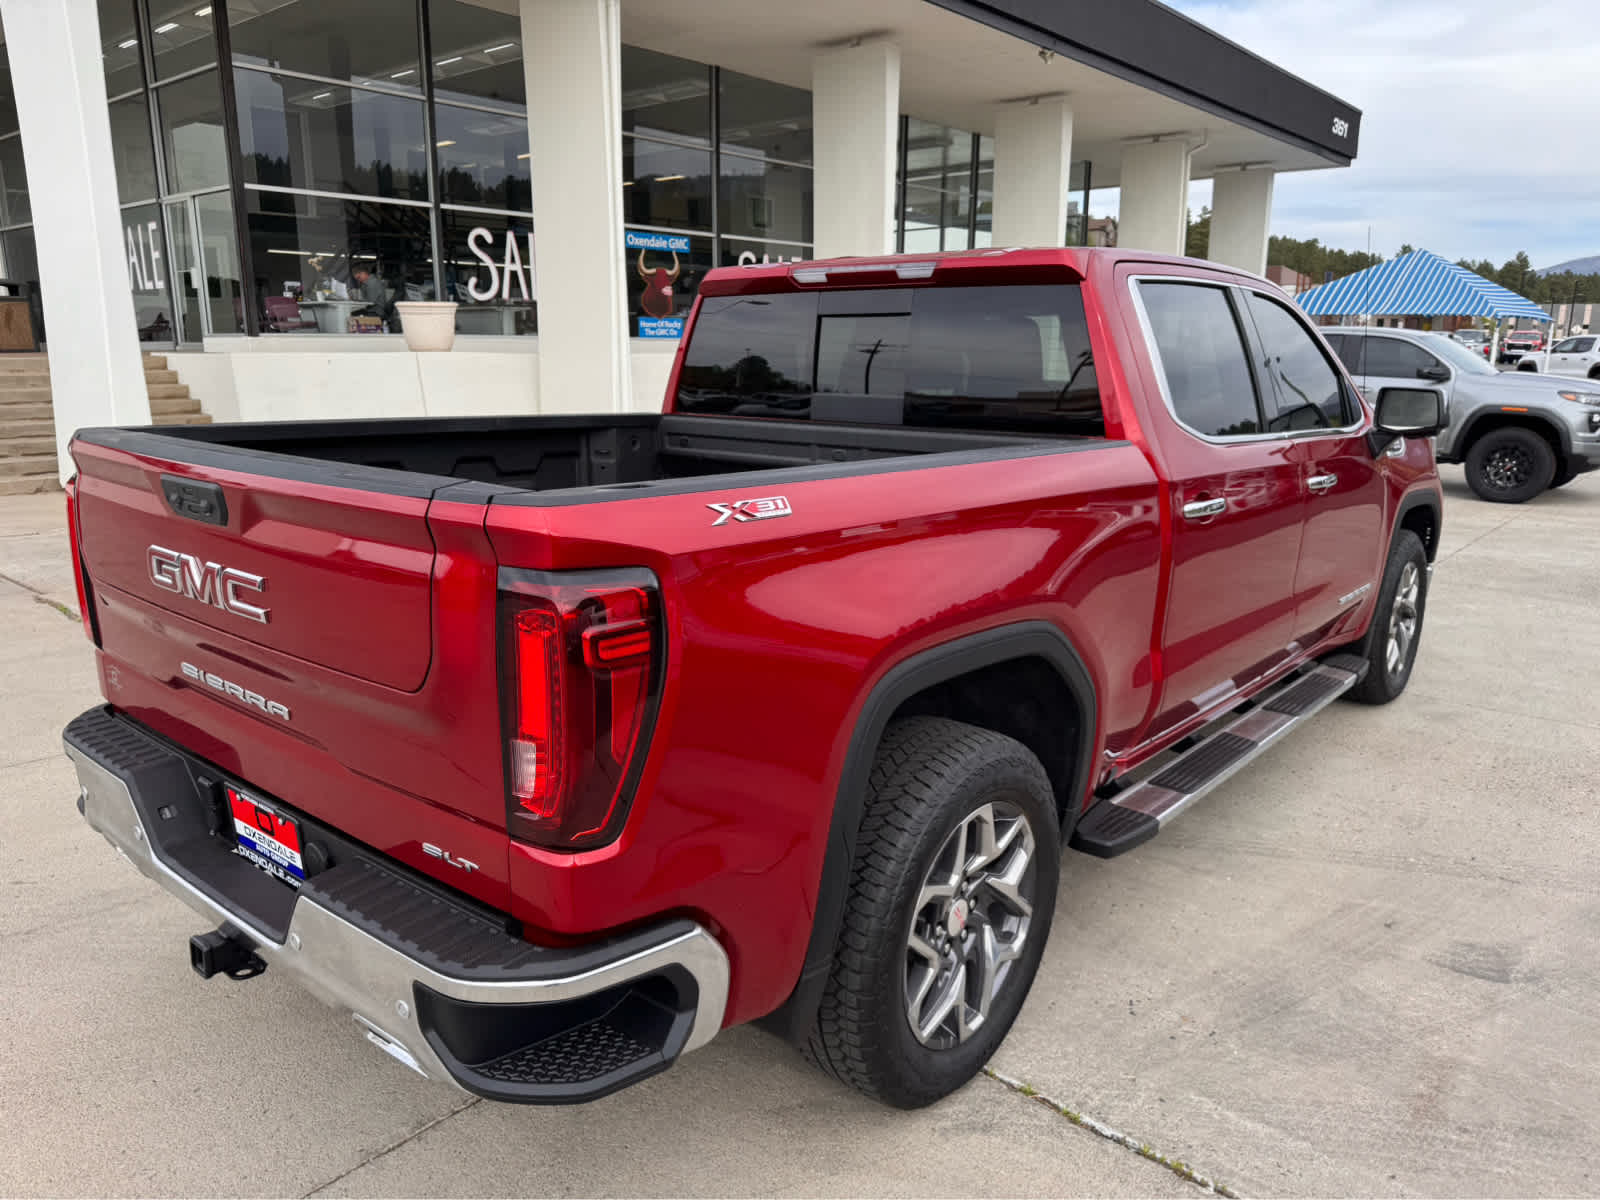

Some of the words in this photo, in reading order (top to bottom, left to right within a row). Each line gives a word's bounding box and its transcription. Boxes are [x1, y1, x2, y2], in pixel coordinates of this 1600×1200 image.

[1332, 117, 1349, 139] 361
[127, 221, 165, 291] ALE
[627, 234, 668, 249] Oxendale
[668, 238, 690, 250] GMC
[705, 496, 792, 526] X31
[147, 544, 269, 624] GMC
[181, 661, 291, 720] SIERRA
[243, 825, 297, 863] OXENDALE
[422, 841, 480, 872] SLT
